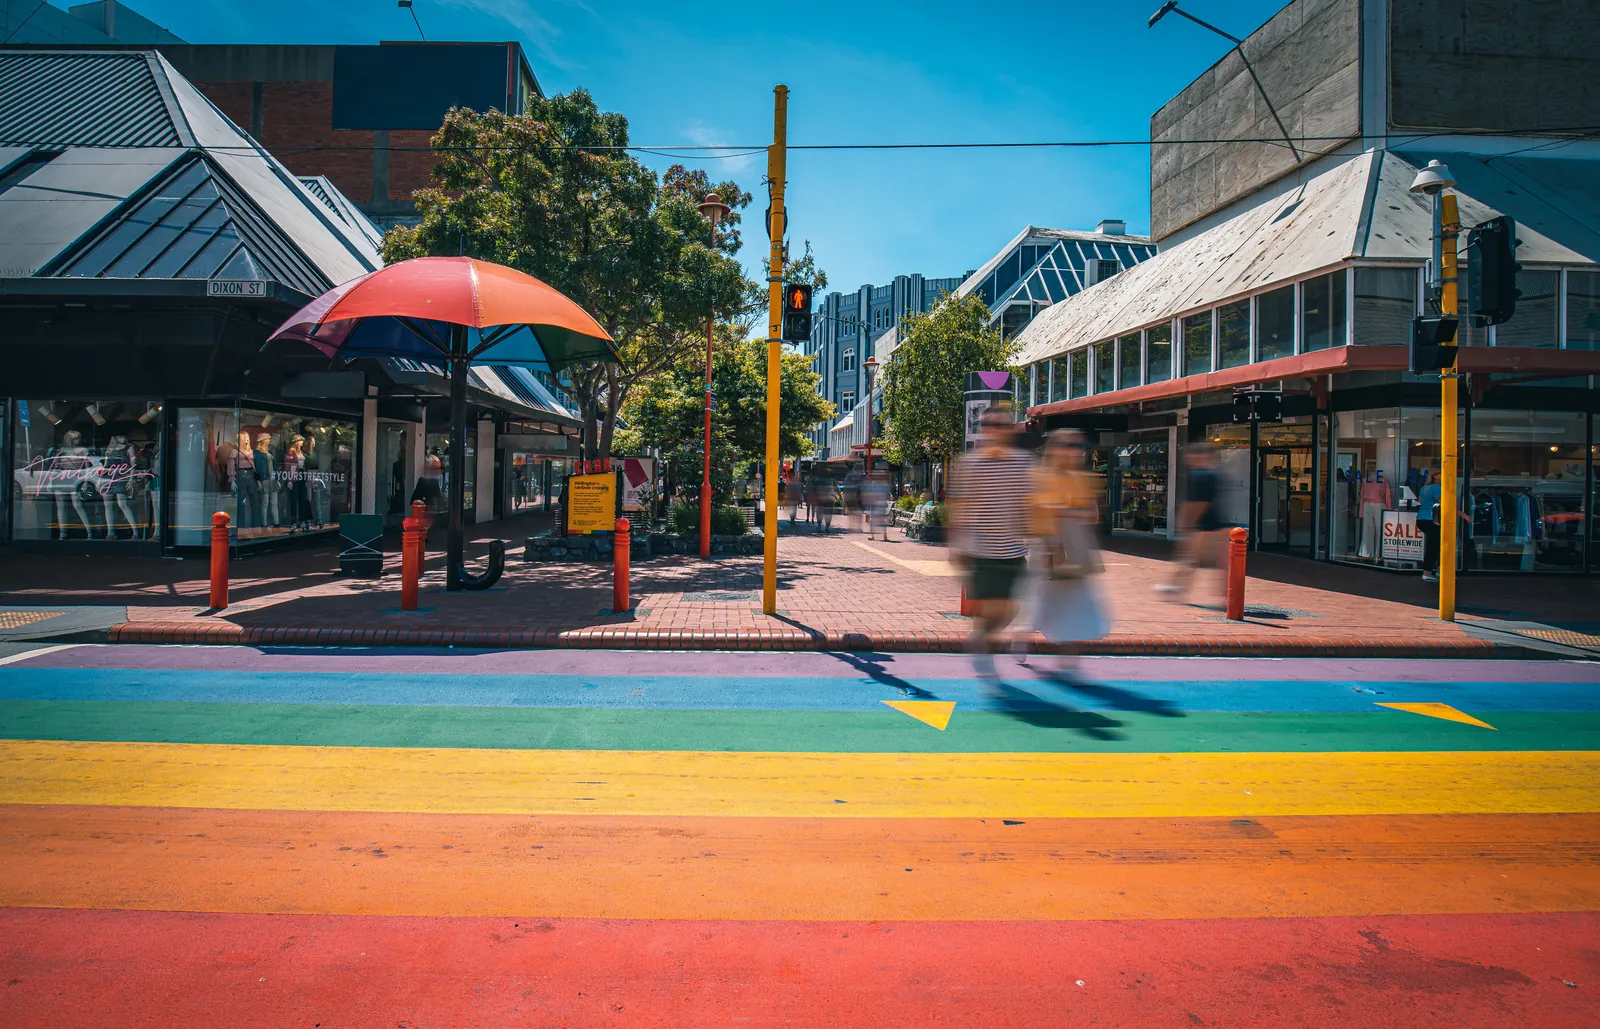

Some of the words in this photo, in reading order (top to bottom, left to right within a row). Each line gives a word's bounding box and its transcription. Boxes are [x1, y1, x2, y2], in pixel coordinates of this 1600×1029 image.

[212, 282, 243, 294] DIXON
[249, 283, 260, 294] ST
[574, 458, 610, 475] CUBA
[28, 452, 155, 496] Vintage
[271, 470, 345, 482] #YOURSTREETSTYLE
[1345, 470, 1384, 484] SALE
[1384, 522, 1422, 538] SALE
[1384, 538, 1422, 547] STOREWIDE
